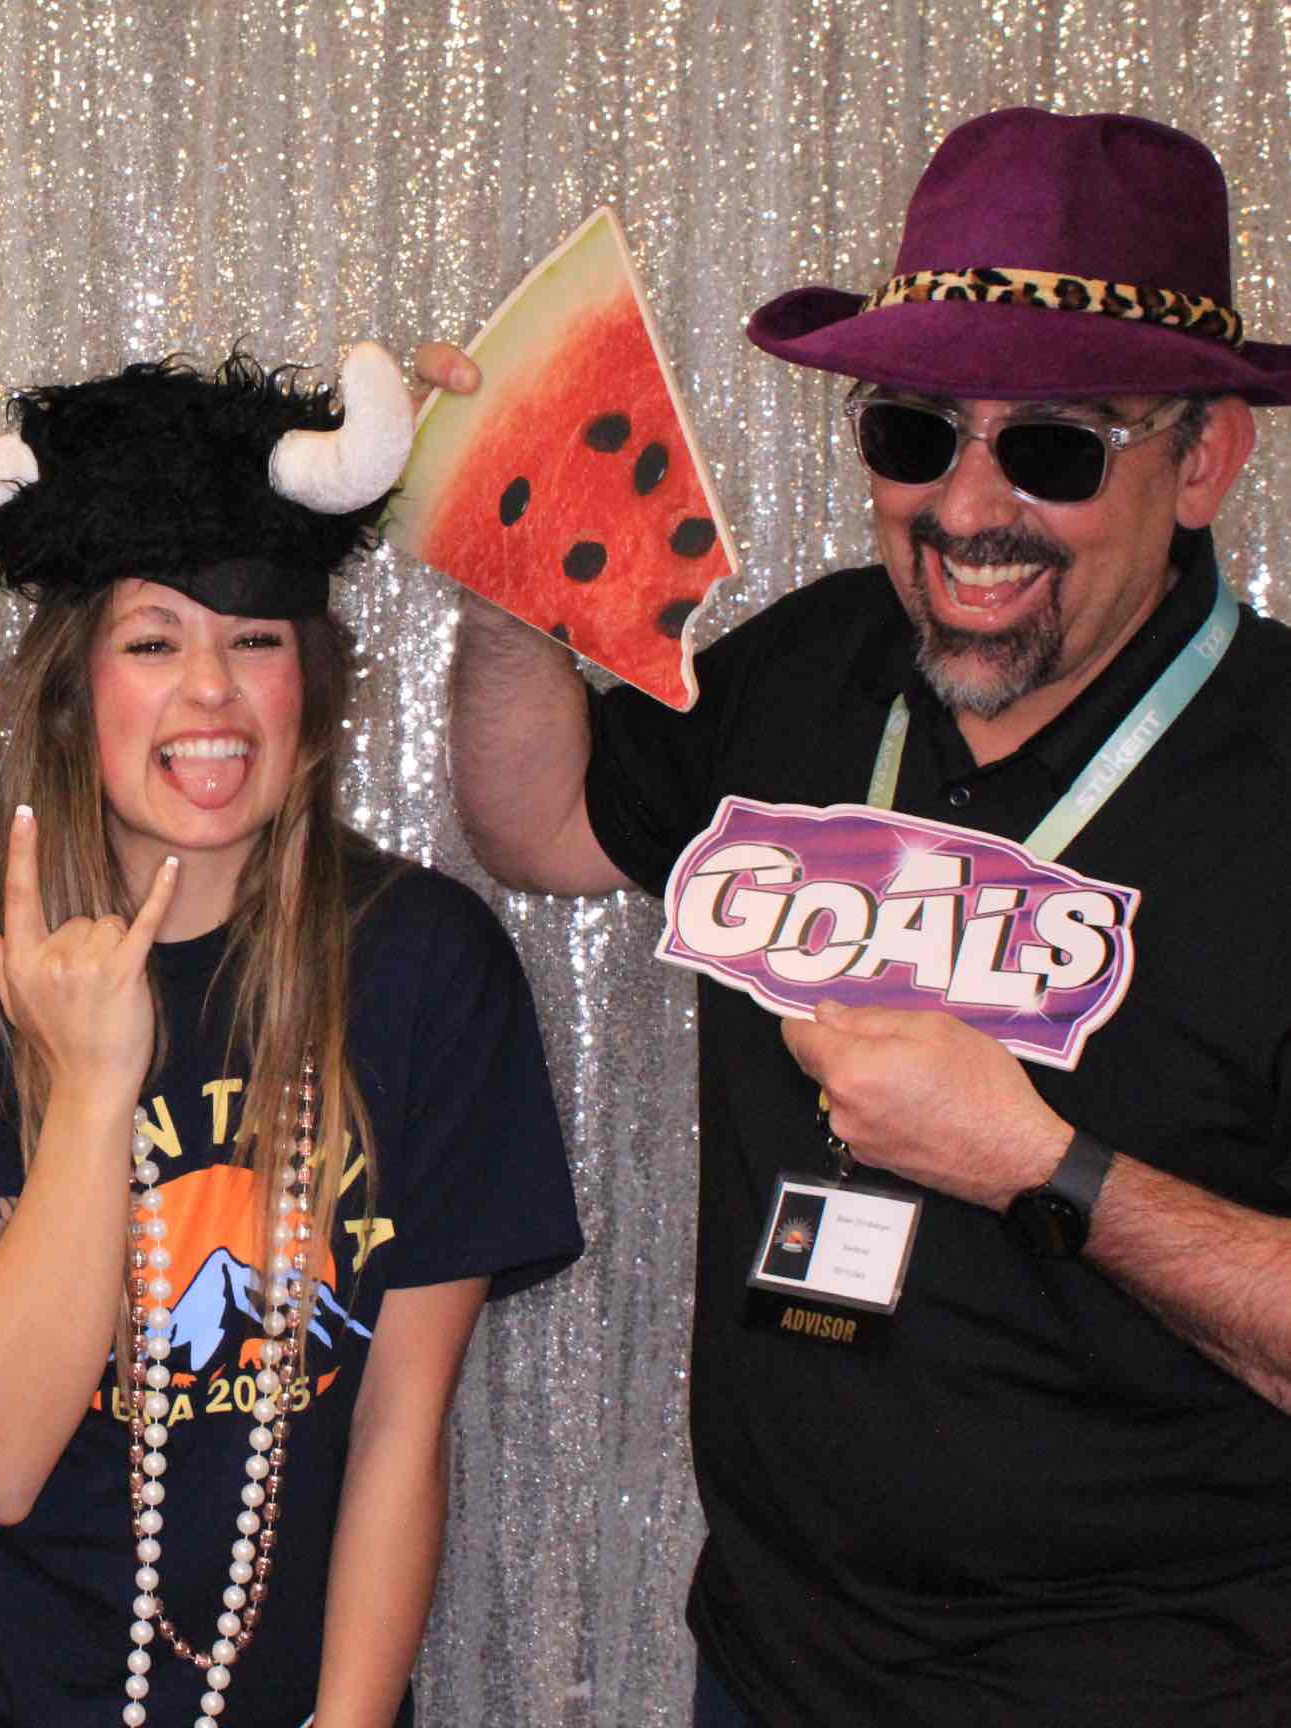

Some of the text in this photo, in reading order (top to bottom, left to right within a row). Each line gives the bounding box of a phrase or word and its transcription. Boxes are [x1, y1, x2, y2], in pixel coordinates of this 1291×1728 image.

[677, 843, 1124, 1007] GOALS
[780, 1307, 857, 1342] ADVISOR
[206, 1375, 310, 1413] 205
